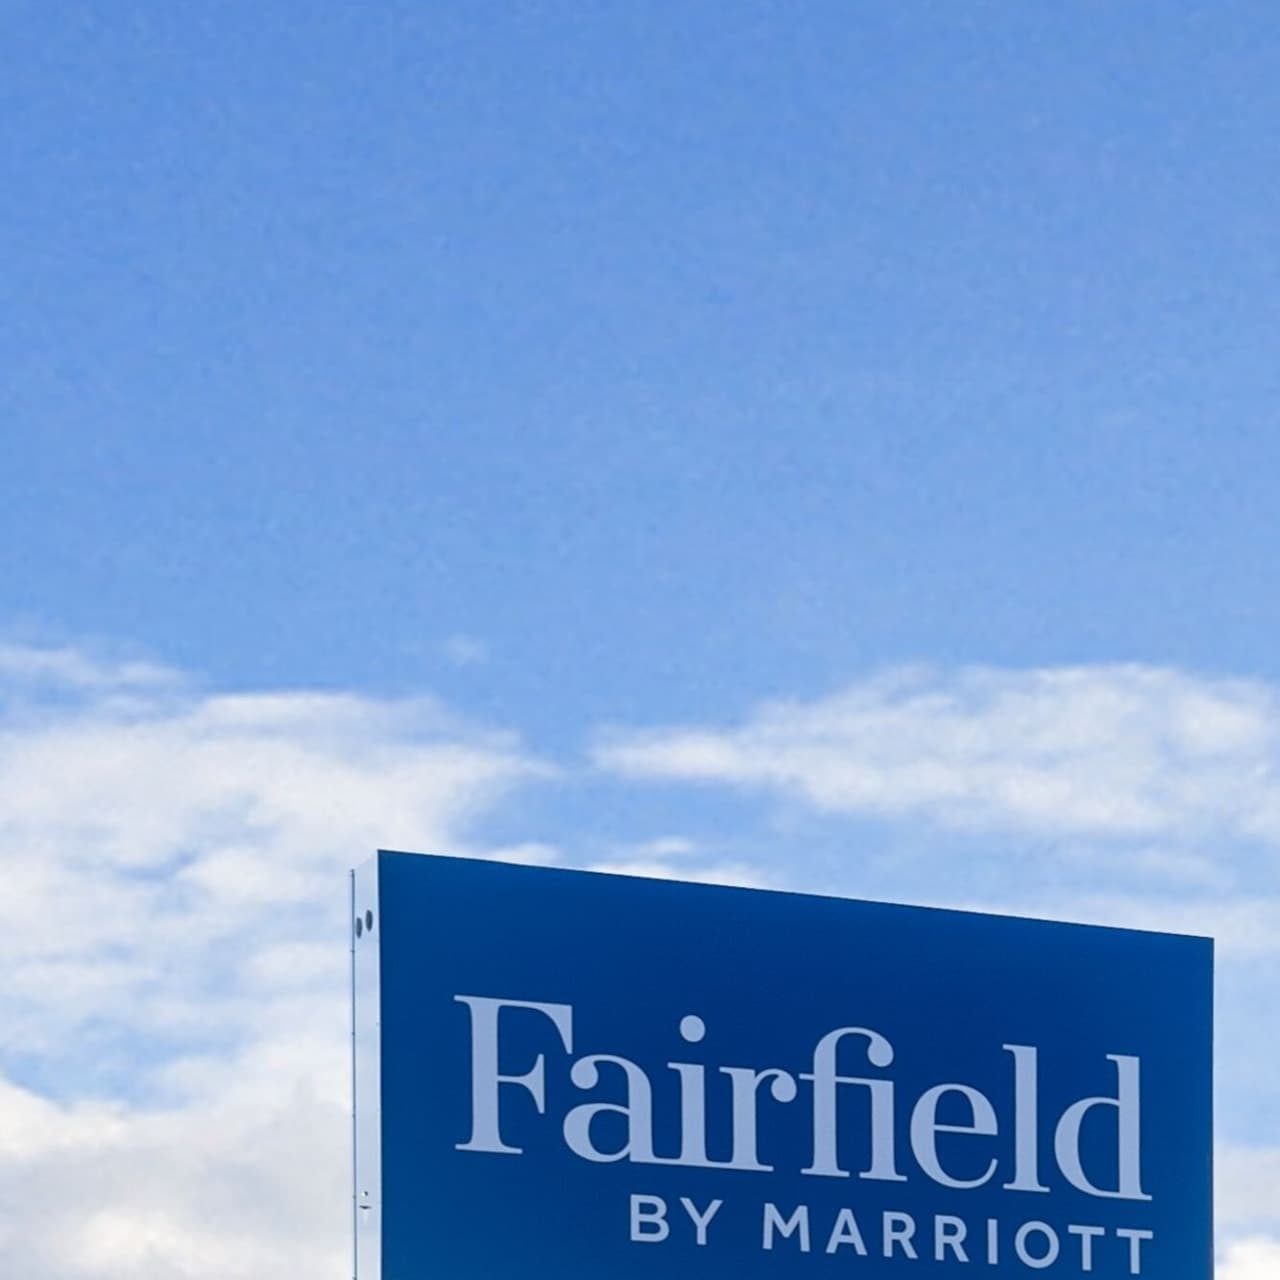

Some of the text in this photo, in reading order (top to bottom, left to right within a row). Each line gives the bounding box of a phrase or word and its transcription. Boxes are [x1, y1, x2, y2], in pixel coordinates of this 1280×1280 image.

[454, 994, 1154, 1202] Fairfield
[630, 1193, 1154, 1275] BY MARRIOTT
